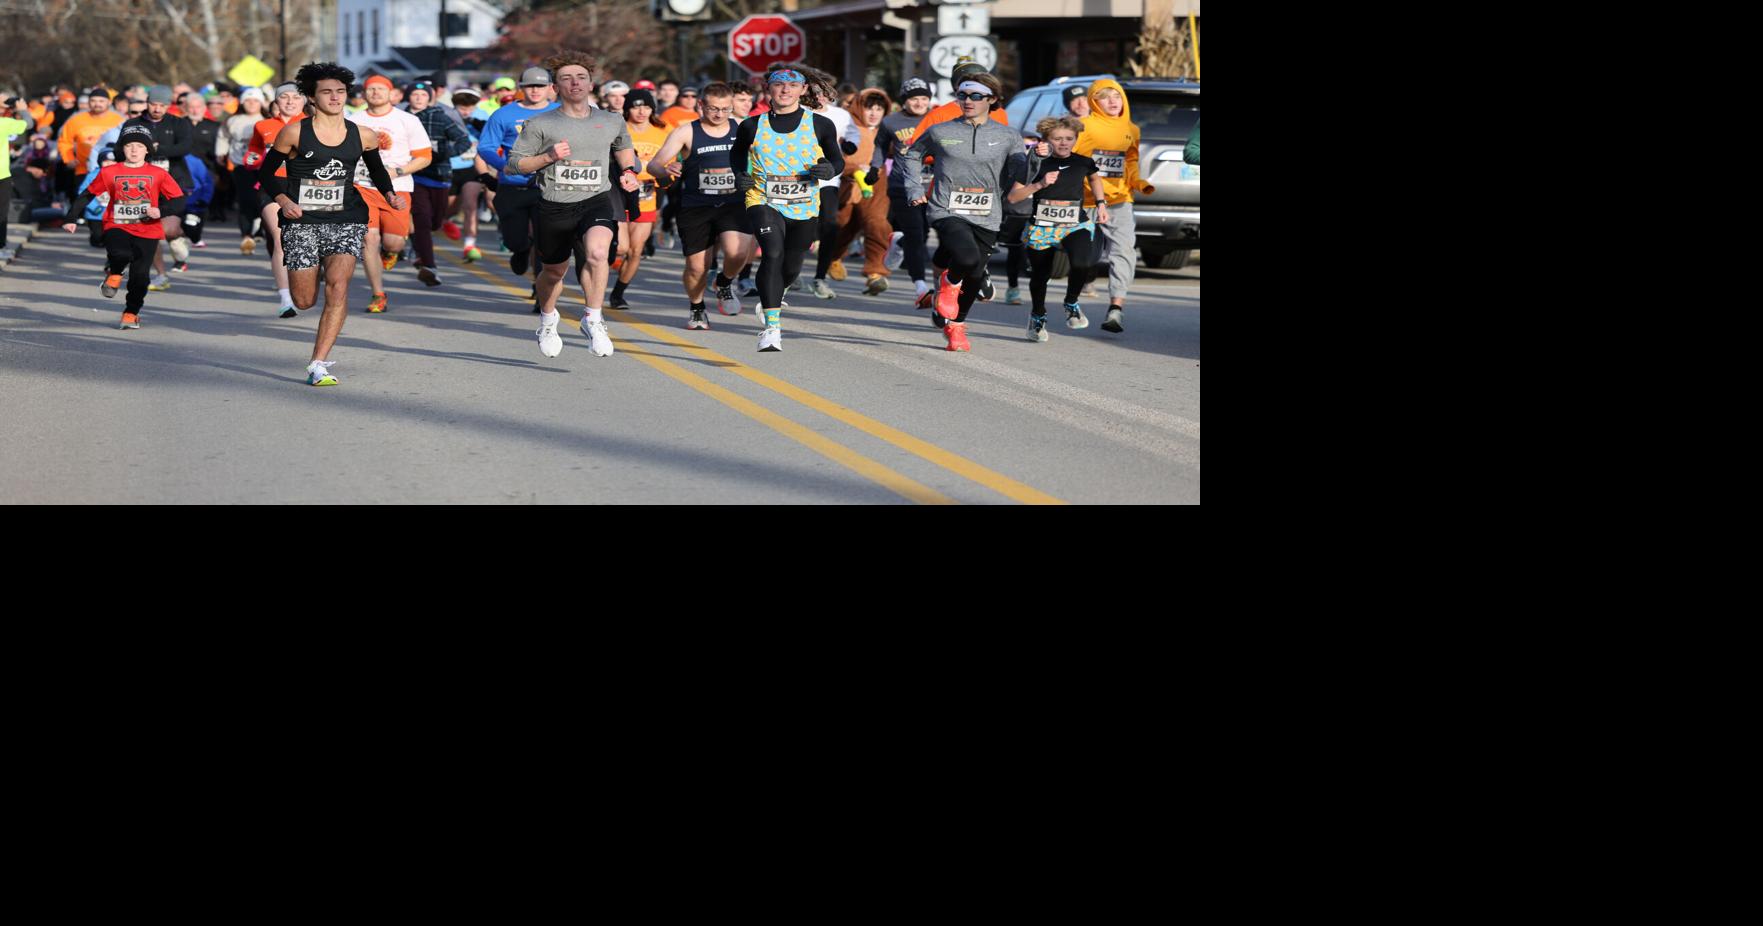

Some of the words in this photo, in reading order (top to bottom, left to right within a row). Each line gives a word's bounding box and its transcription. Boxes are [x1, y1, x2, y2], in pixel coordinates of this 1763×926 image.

[735, 33, 799, 57] STOP
[697, 144, 727, 155] SHAWNEE
[1095, 157, 1122, 168] 4423
[313, 168, 347, 176] RELAYS
[560, 168, 598, 180] 4640
[703, 175, 734, 186] 4356
[304, 188, 340, 200] 4681
[771, 183, 808, 195] 4524
[954, 194, 989, 205] 4246
[117, 206, 148, 216] 4686
[1041, 207, 1075, 218] 4504
